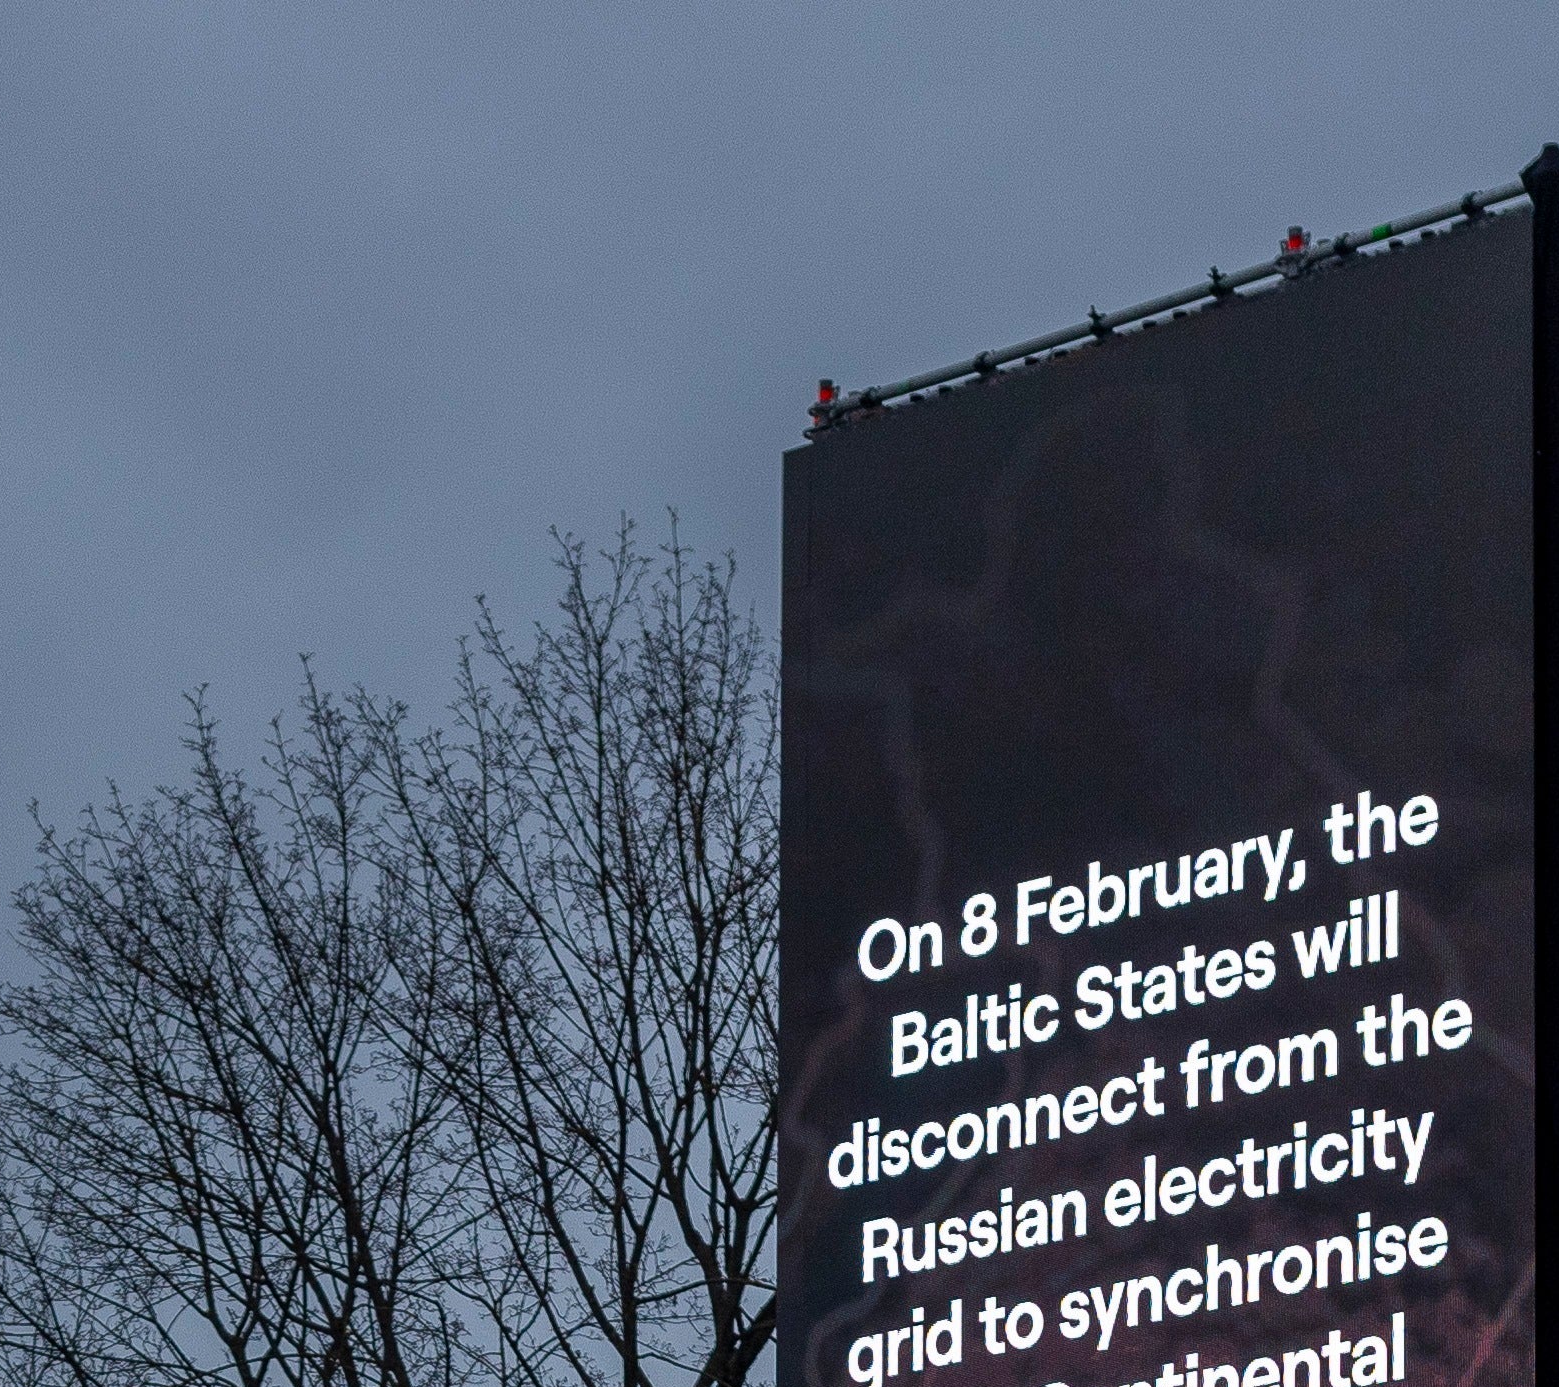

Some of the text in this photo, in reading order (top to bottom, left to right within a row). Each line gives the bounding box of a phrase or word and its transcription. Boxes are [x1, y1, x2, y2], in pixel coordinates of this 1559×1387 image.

[858, 791, 1438, 981] On 8 February, the
[892, 890, 1398, 1077] Baltic States will
[828, 993, 1472, 1189] disconnect from the
[863, 1109, 1434, 1282] Russian electricity
[979, 1297, 1044, 1354] to
[1059, 1211, 1448, 1350] synchronise
